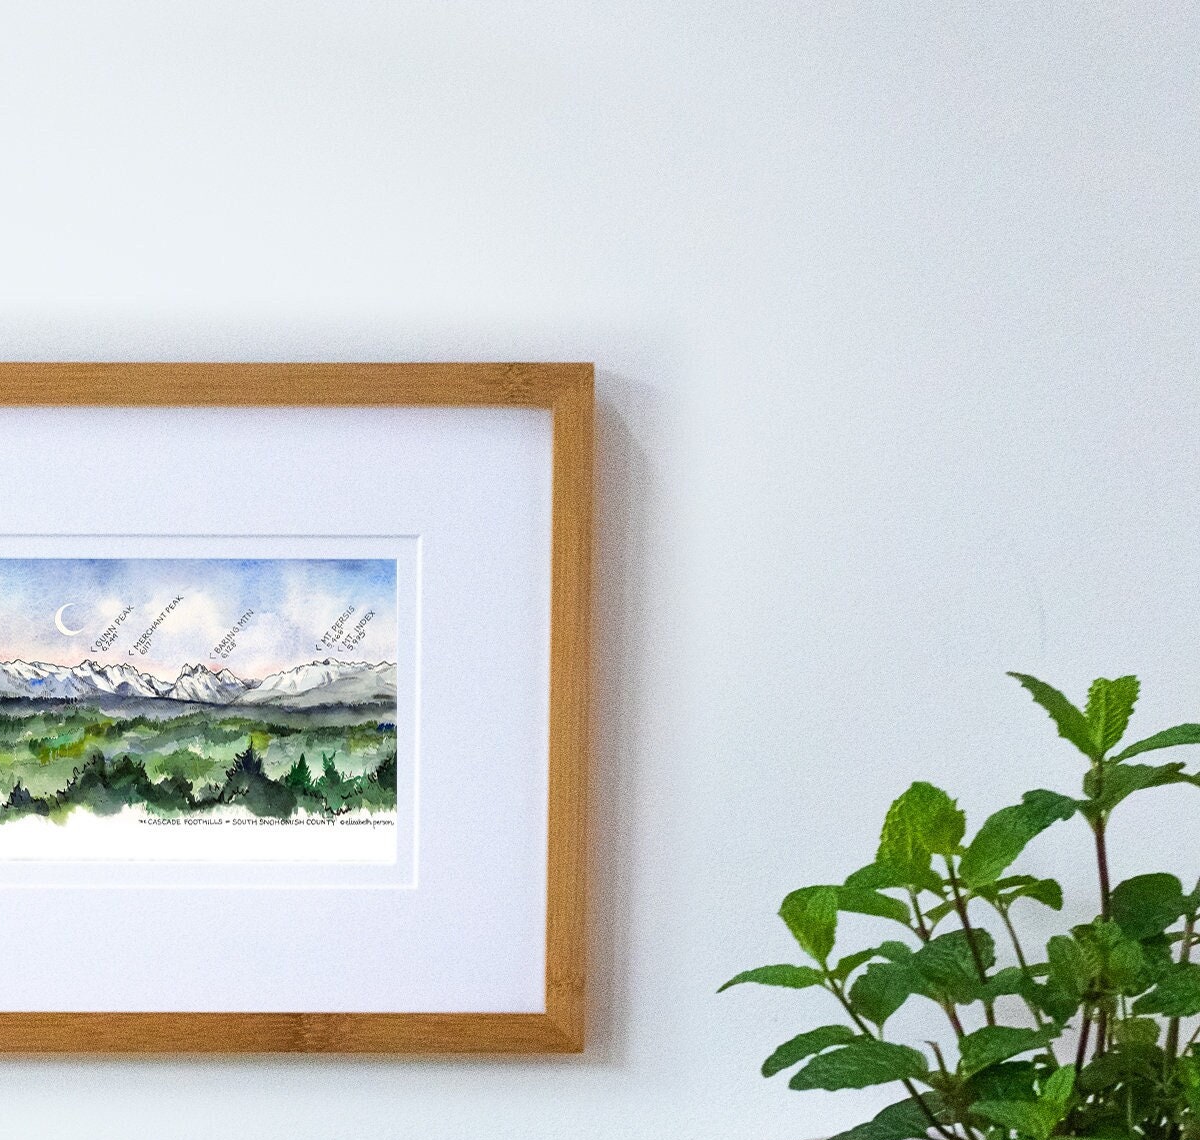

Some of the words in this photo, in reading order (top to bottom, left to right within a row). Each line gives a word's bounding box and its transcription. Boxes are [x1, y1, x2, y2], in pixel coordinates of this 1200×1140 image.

[95, 624, 117, 648] GUNN
[114, 605, 134, 626] PEAK
[133, 612, 166, 651] MERCHANT
[165, 594, 185, 614] PEAK
[331, 605, 356, 632] PERSIS
[354, 610, 376, 633] INDEX
[213, 625, 240, 655] BARING
[147, 818, 181, 826] CASCADE
[184, 818, 223, 826] FOOTHILLS
[232, 818, 258, 826] SOUTH
[259, 818, 305, 826] SNOHOMISH
[306, 818, 336, 826] COUNTY
